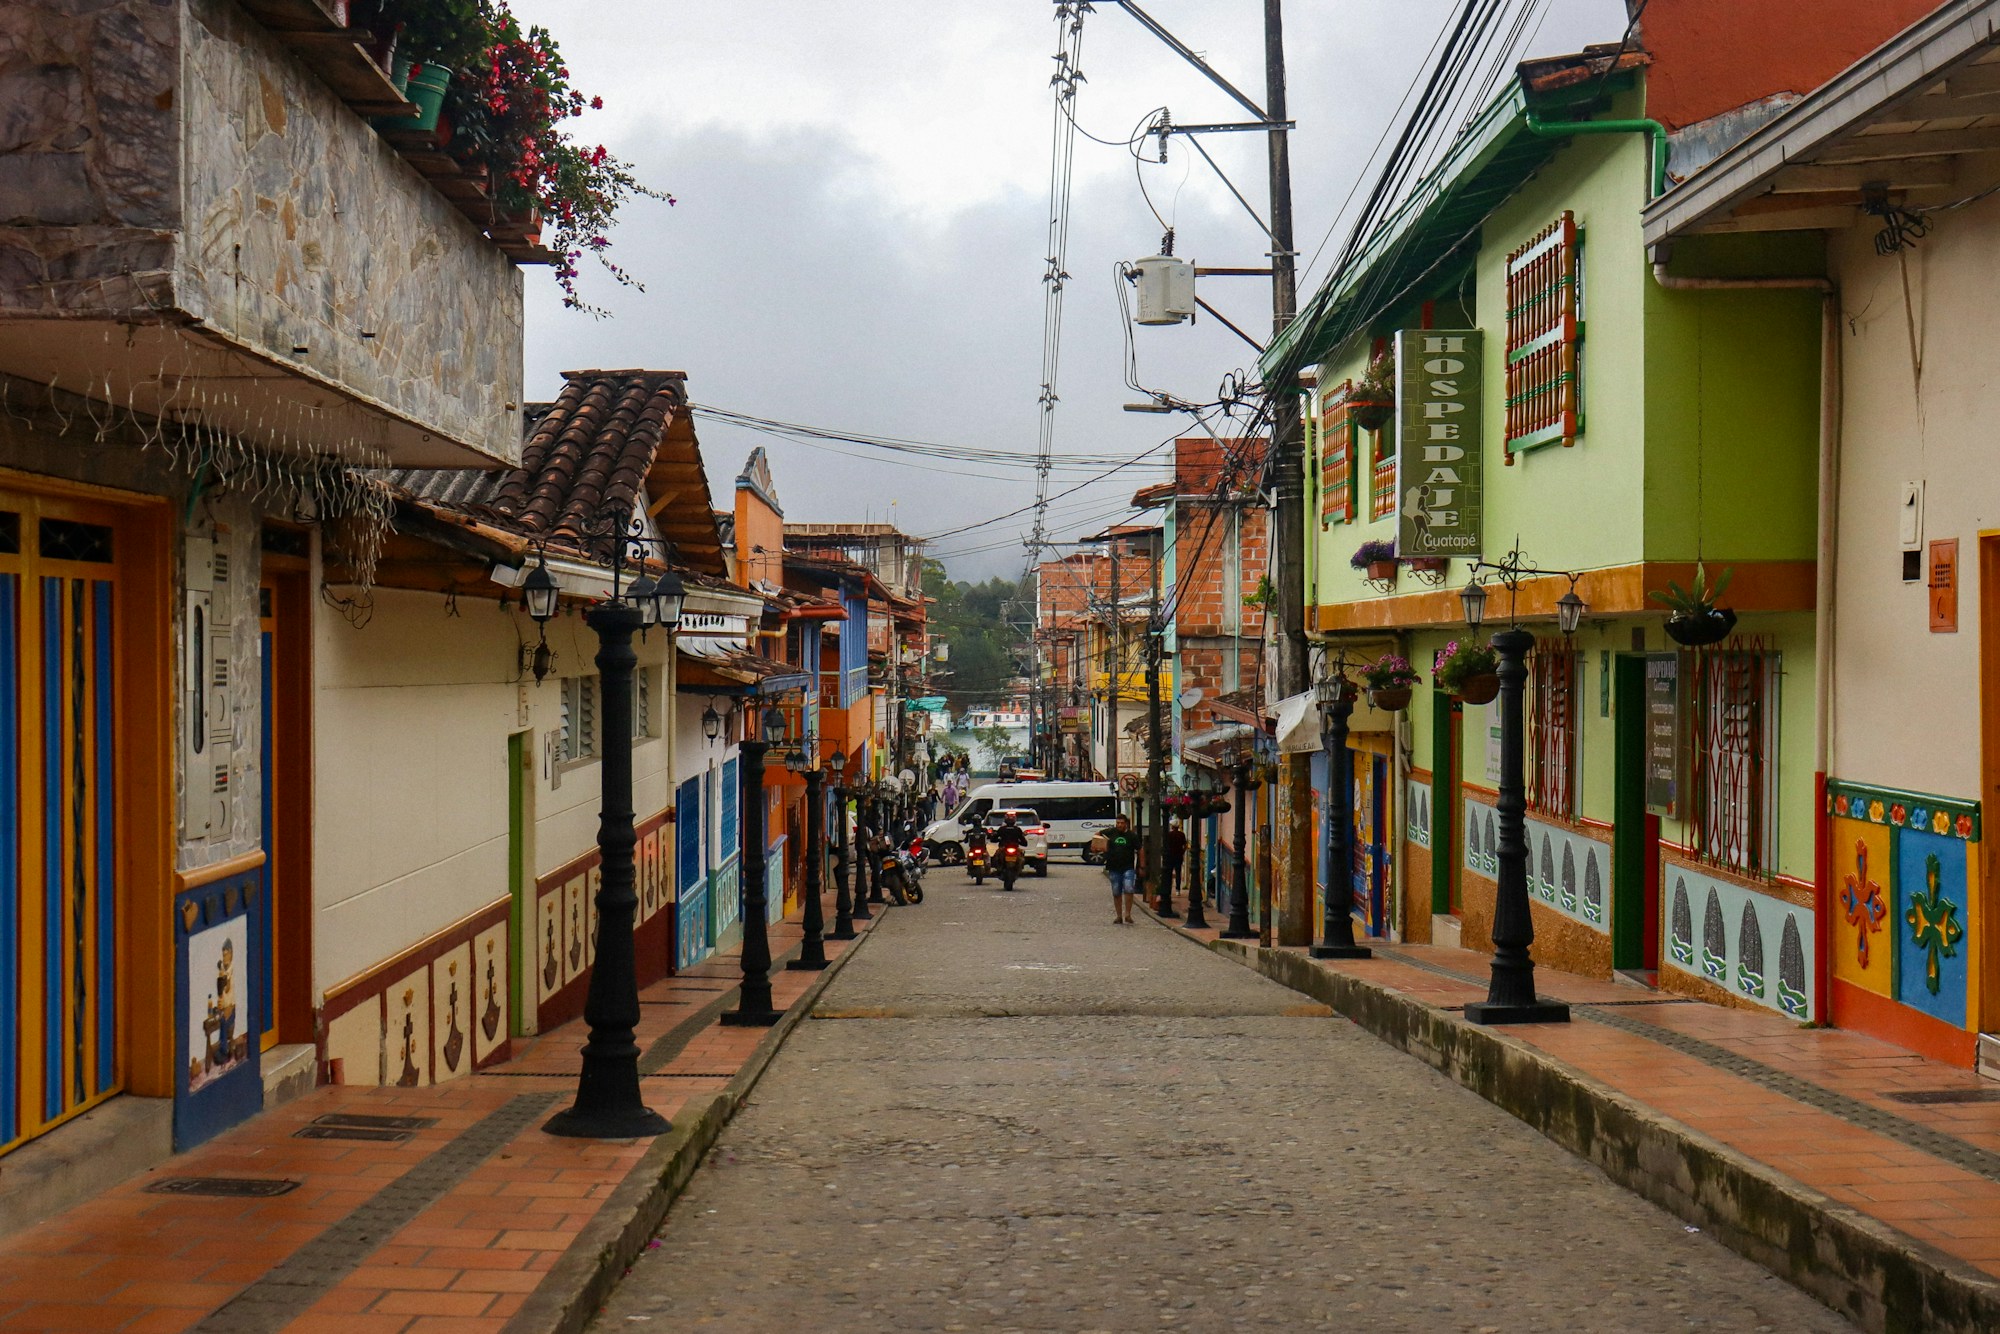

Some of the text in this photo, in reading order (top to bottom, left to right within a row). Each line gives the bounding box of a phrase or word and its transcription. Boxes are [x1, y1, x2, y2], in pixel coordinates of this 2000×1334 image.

[1422, 336, 1466, 527] HOSPEDAJE
[1423, 533, 1476, 552] Guatapé
[1648, 661, 1675, 680] HOSPEDAJE
